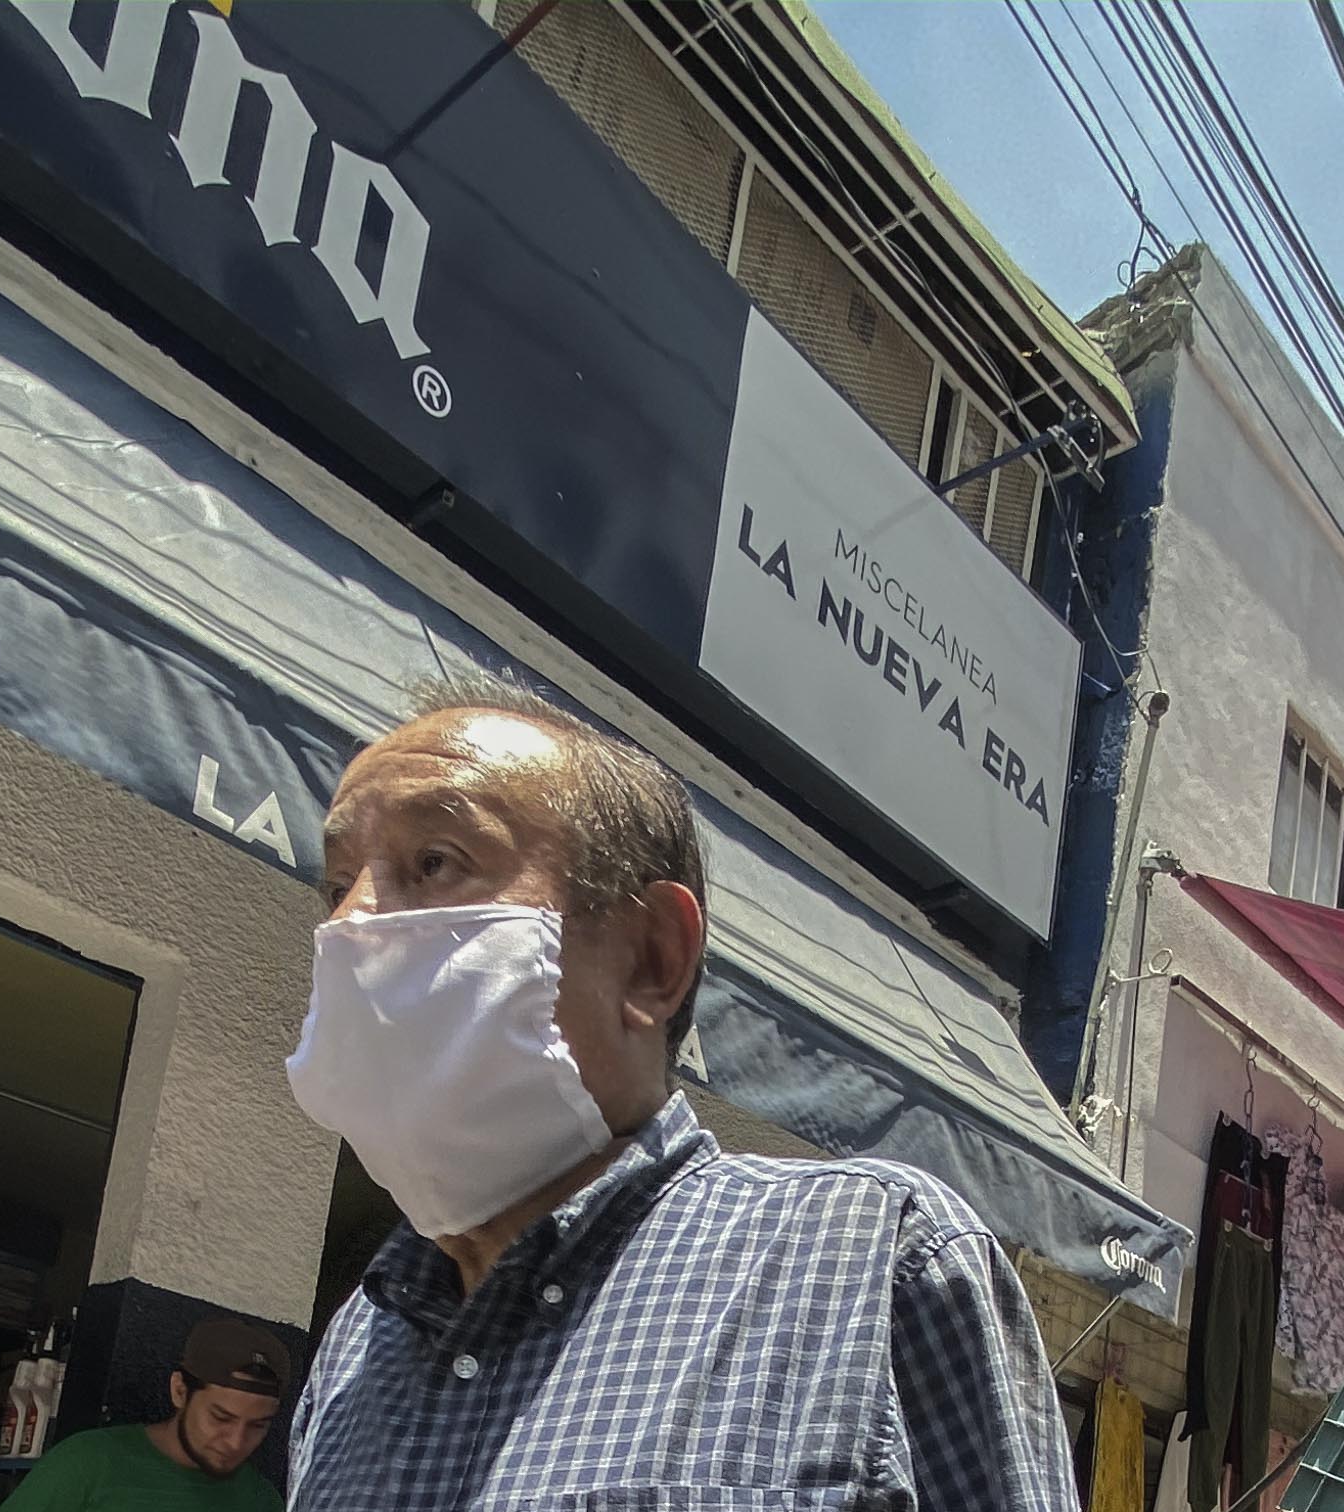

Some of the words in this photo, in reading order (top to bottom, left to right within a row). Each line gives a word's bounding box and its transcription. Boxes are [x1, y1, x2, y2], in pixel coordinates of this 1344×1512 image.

[9, 0, 431, 360] ona
[737, 503, 797, 600] LA
[817, 577, 966, 751] NUEVA
[982, 727, 1050, 827] ERA
[834, 528, 998, 706] MISCELANEA
[192, 754, 297, 869] LA
[1101, 1236, 1166, 1294] Corona
